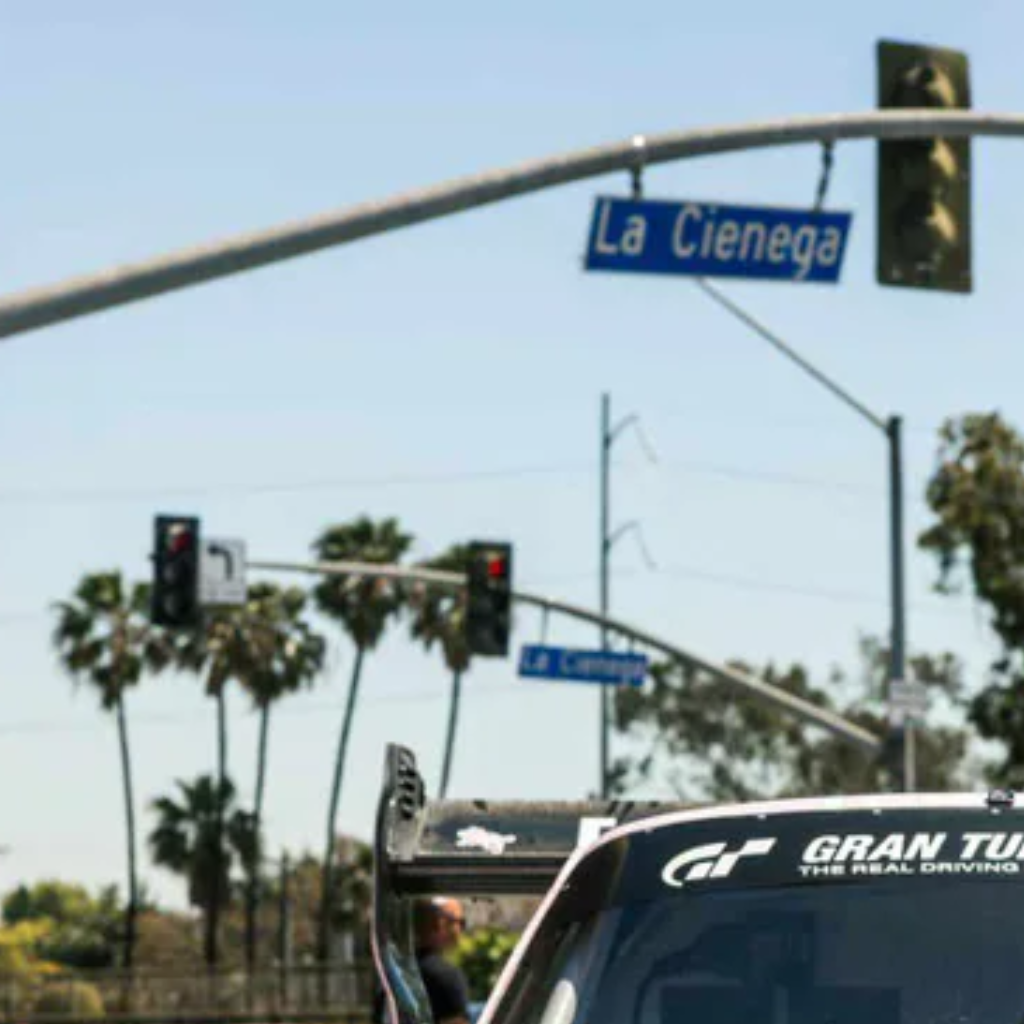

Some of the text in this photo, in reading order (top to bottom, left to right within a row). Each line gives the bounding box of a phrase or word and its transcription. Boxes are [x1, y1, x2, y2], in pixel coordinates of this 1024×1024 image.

[595, 203, 841, 279] La Cienega
[661, 837, 777, 888] GT
[802, 832, 947, 864] GRAN
[799, 863, 845, 876] THE
[853, 862, 914, 875] REAL
[920, 862, 1019, 874] DRIVING
